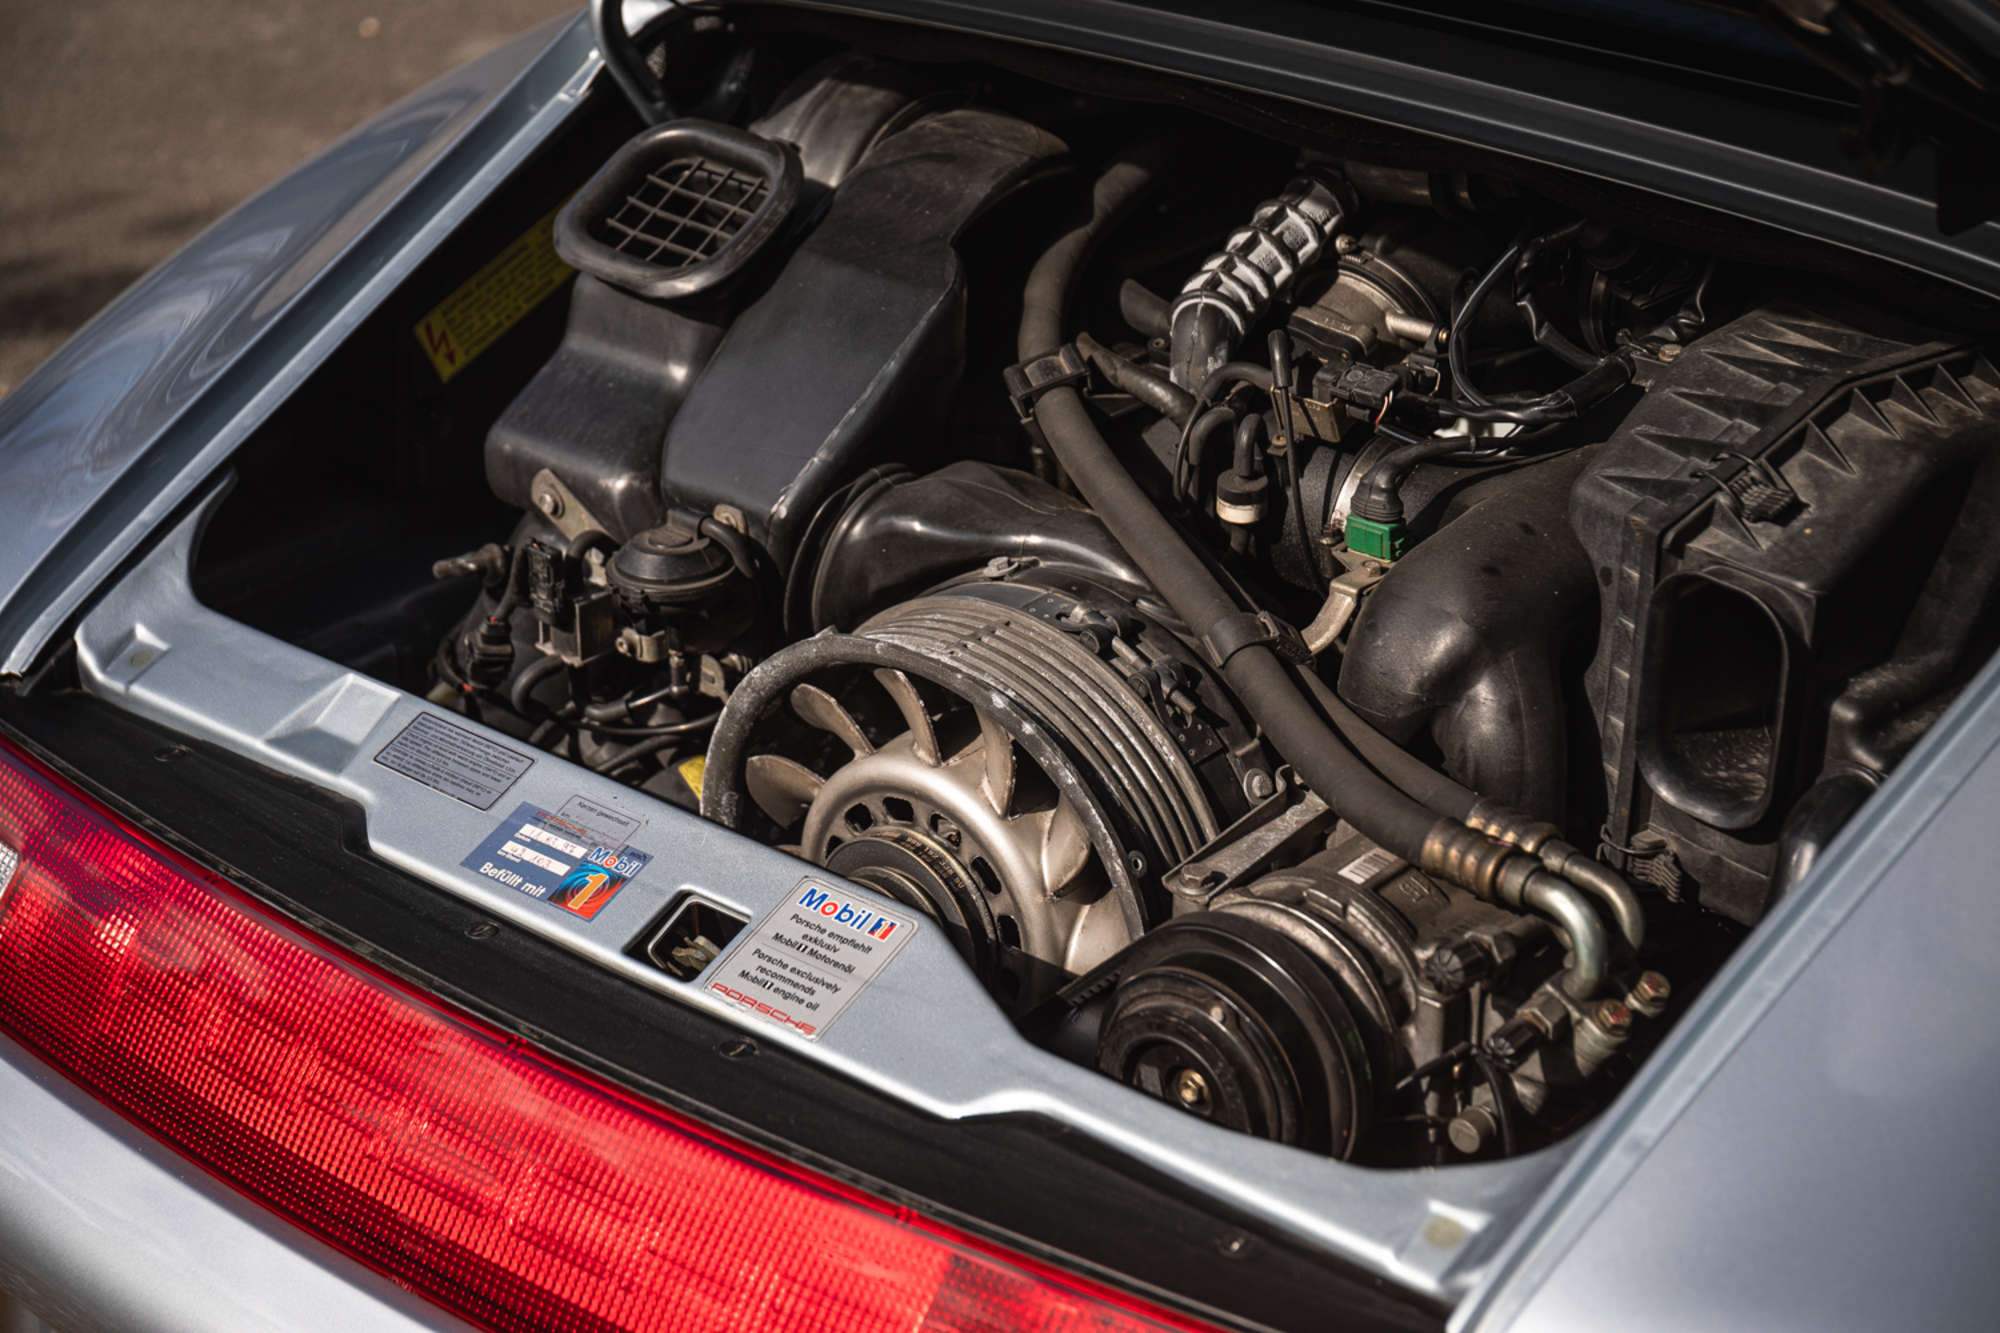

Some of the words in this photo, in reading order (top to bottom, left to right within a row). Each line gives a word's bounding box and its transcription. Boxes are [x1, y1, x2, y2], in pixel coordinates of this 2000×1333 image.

[479, 861, 524, 889] Befüllt
[521, 881, 546, 898] mit
[588, 847, 642, 878] Mobil
[798, 887, 873, 931] Mobil
[790, 913, 827, 935] Porsche
[827, 931, 873, 954] empfiehlt
[801, 933, 840, 953] exklusiv
[752, 948, 789, 970] Porsche
[789, 967, 841, 994] exclusively
[807, 948, 856, 974] Motorenöl
[755, 965, 817, 996] recommends
[711, 981, 817, 1036] PORSCHE
[773, 986, 805, 1005] engine
[805, 1000, 820, 1012] oil
